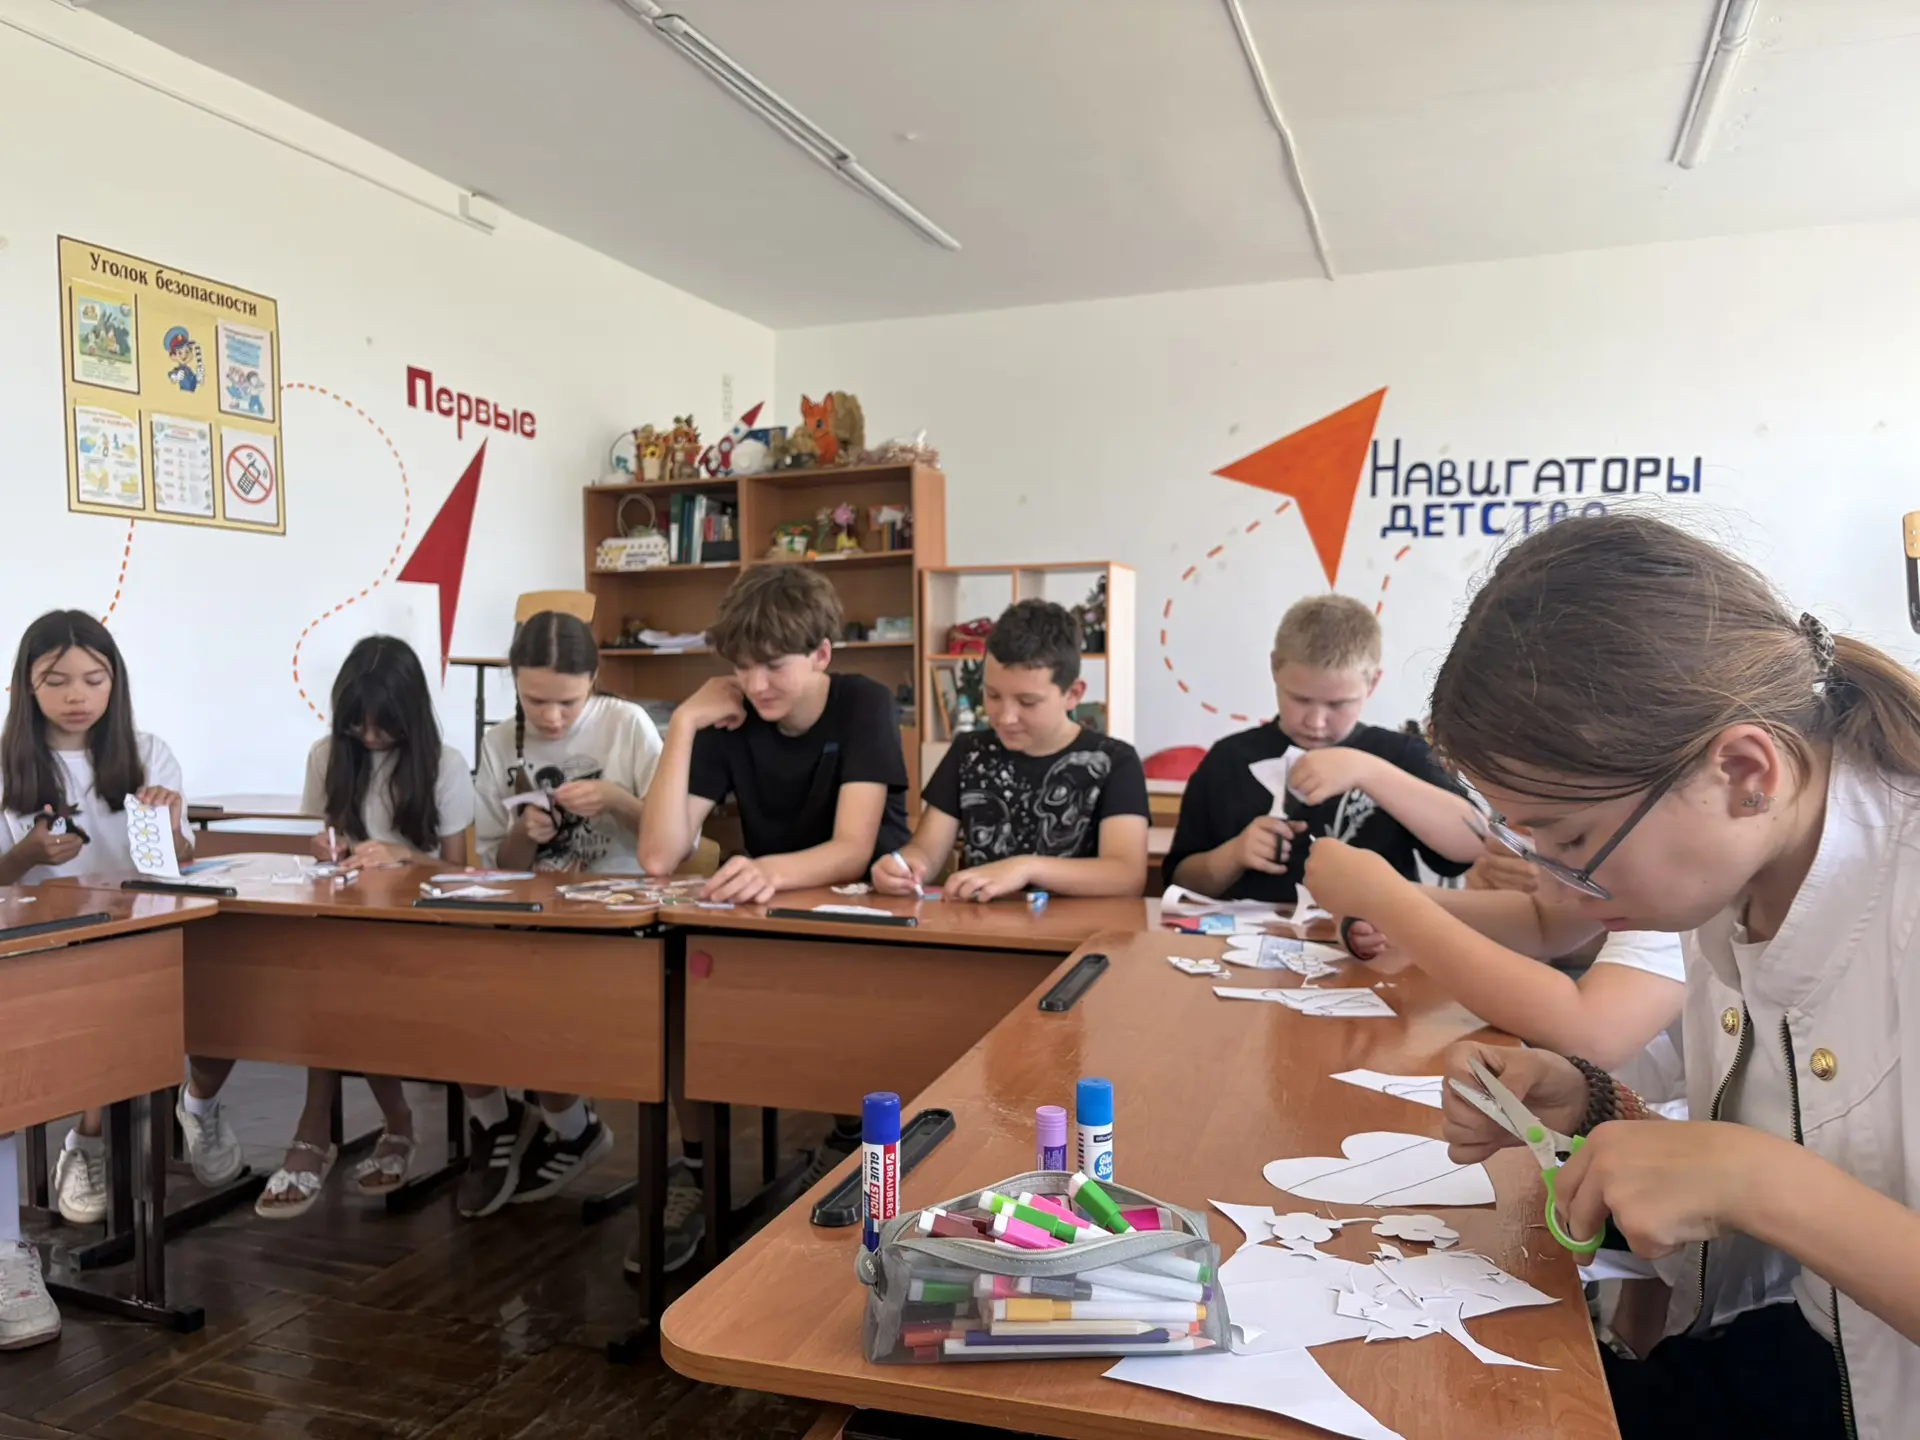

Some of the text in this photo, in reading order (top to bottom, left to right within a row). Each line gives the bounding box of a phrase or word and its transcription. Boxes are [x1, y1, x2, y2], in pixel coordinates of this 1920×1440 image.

[89, 251, 258, 317] Уголок безопасности
[406, 364, 537, 441] Первые
[870, 1151, 880, 1217] GLUE STICK
[885, 1164, 894, 1217] BRAUBERG
